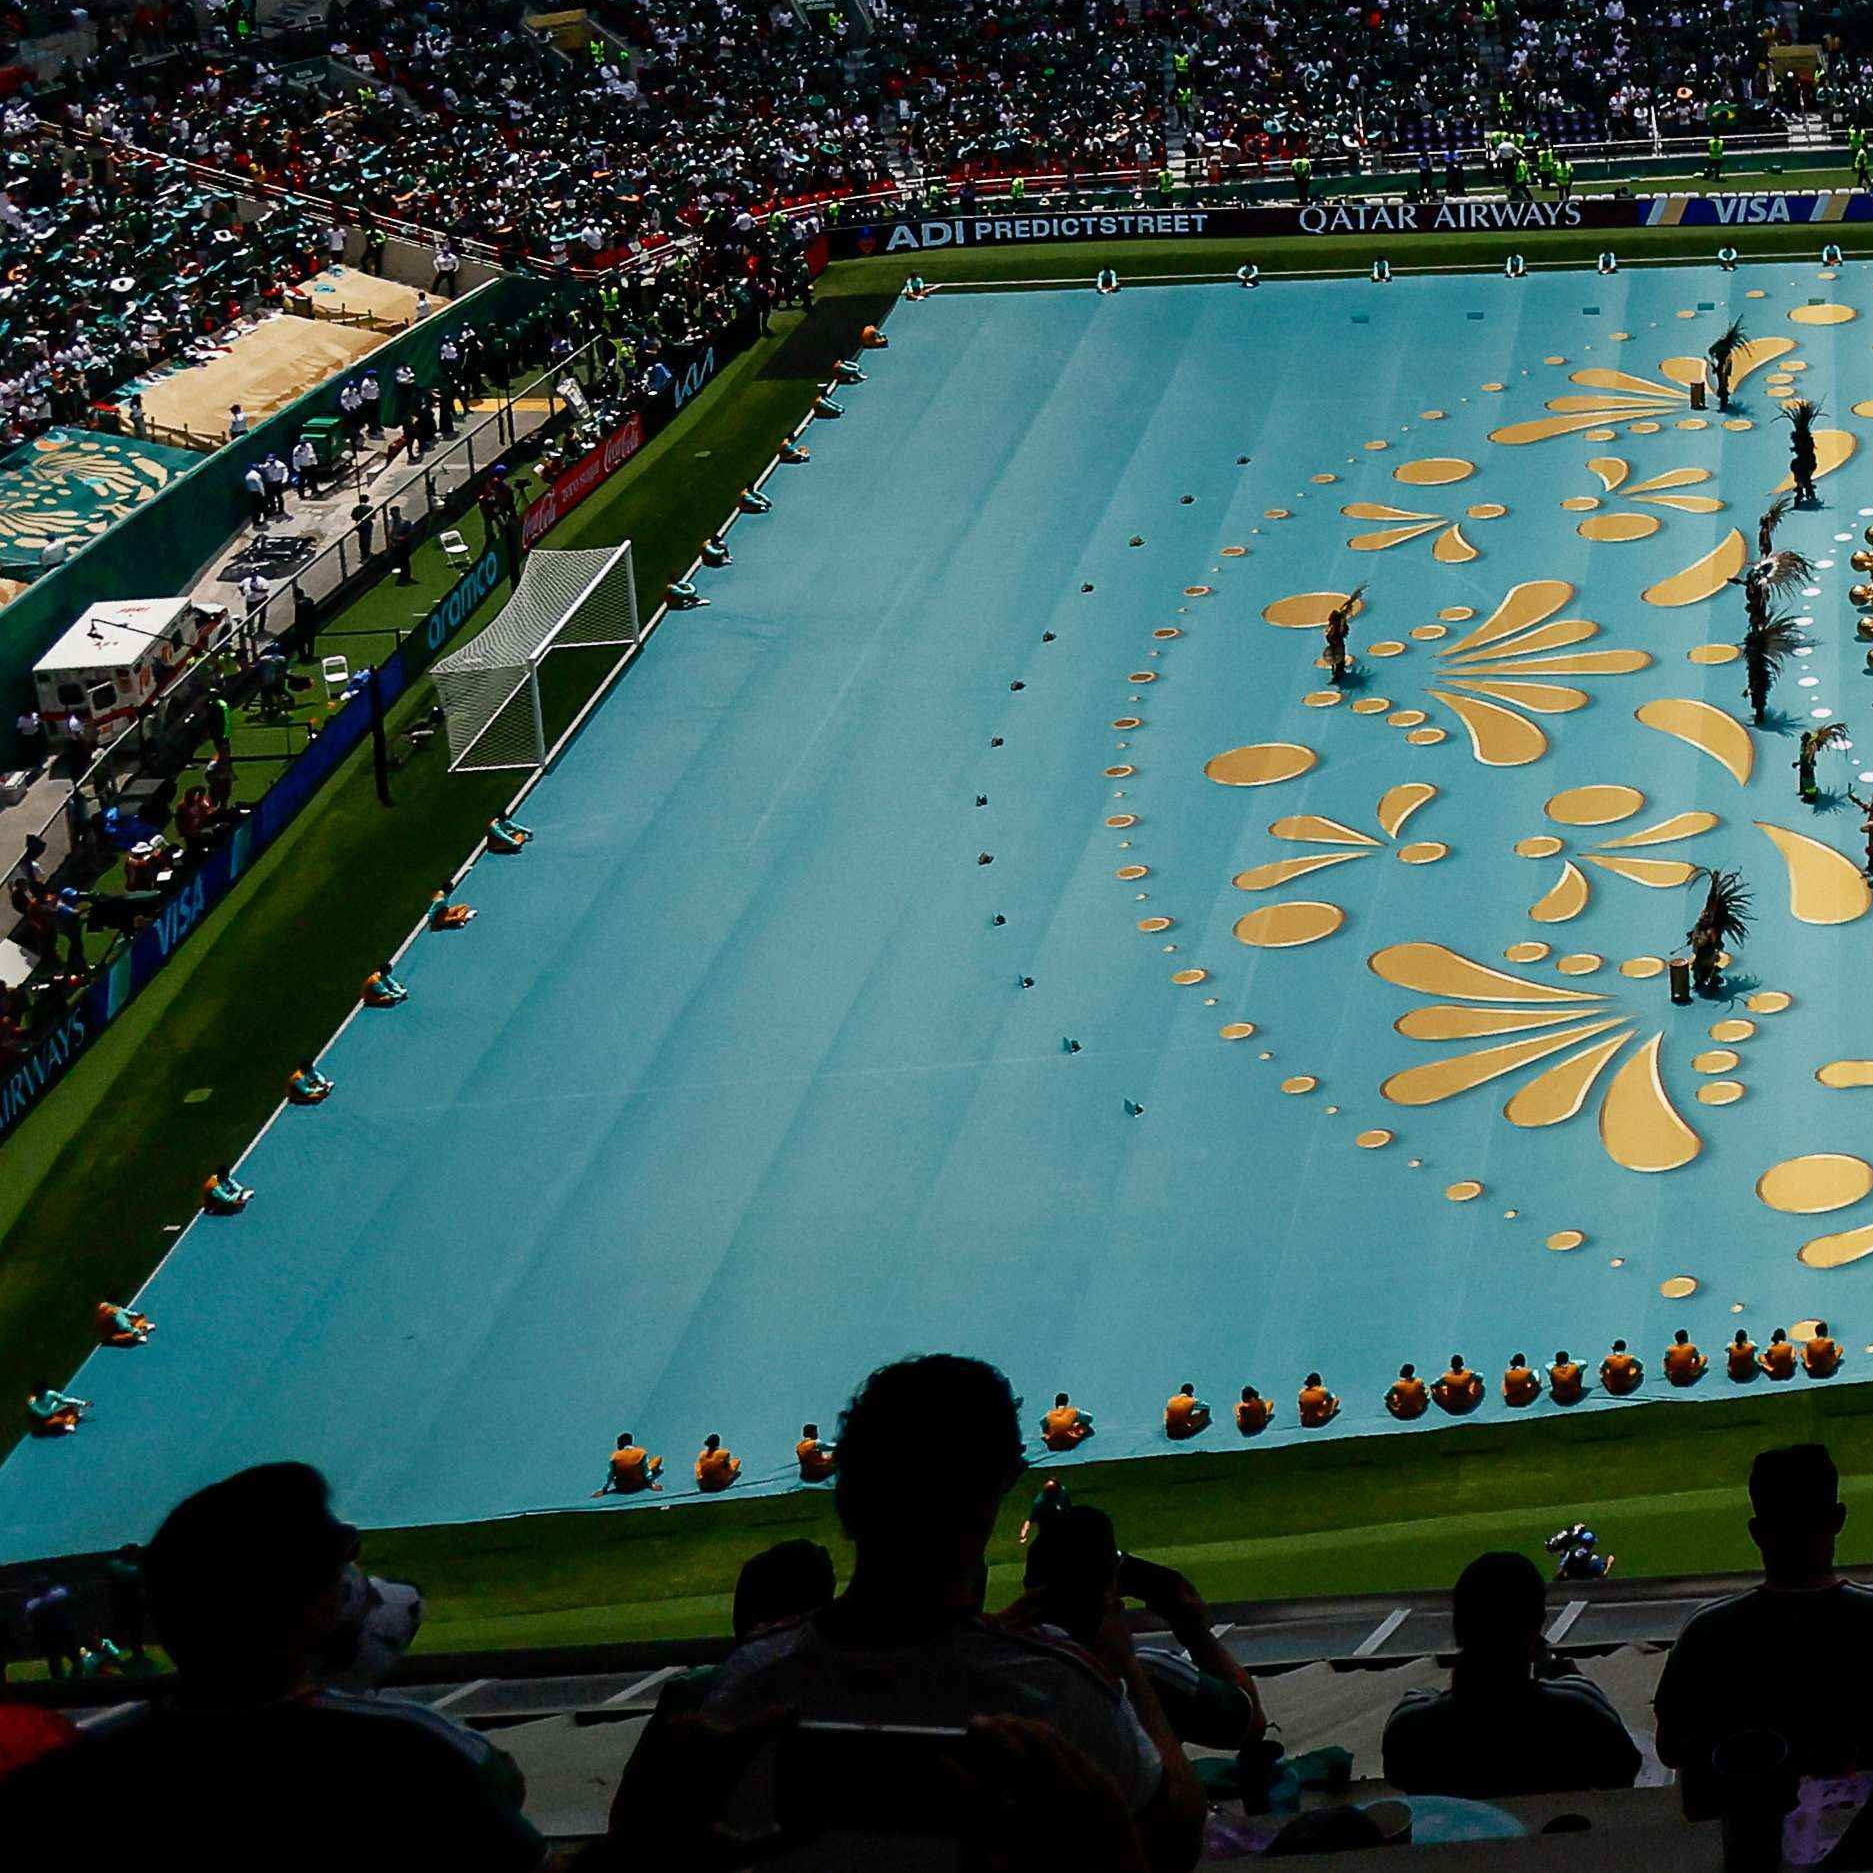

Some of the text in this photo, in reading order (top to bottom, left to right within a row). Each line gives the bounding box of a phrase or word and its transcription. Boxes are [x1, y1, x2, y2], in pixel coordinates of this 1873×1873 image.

[886, 213, 1209, 252] ADI PREDICTSTREET
[1299, 201, 1582, 234] QATAR AIRWAYS
[1712, 197, 1791, 224] VISA
[426, 548, 500, 648] aramco
[152, 868, 207, 958] VISA
[0, 1006, 88, 1129] IRWAYS
